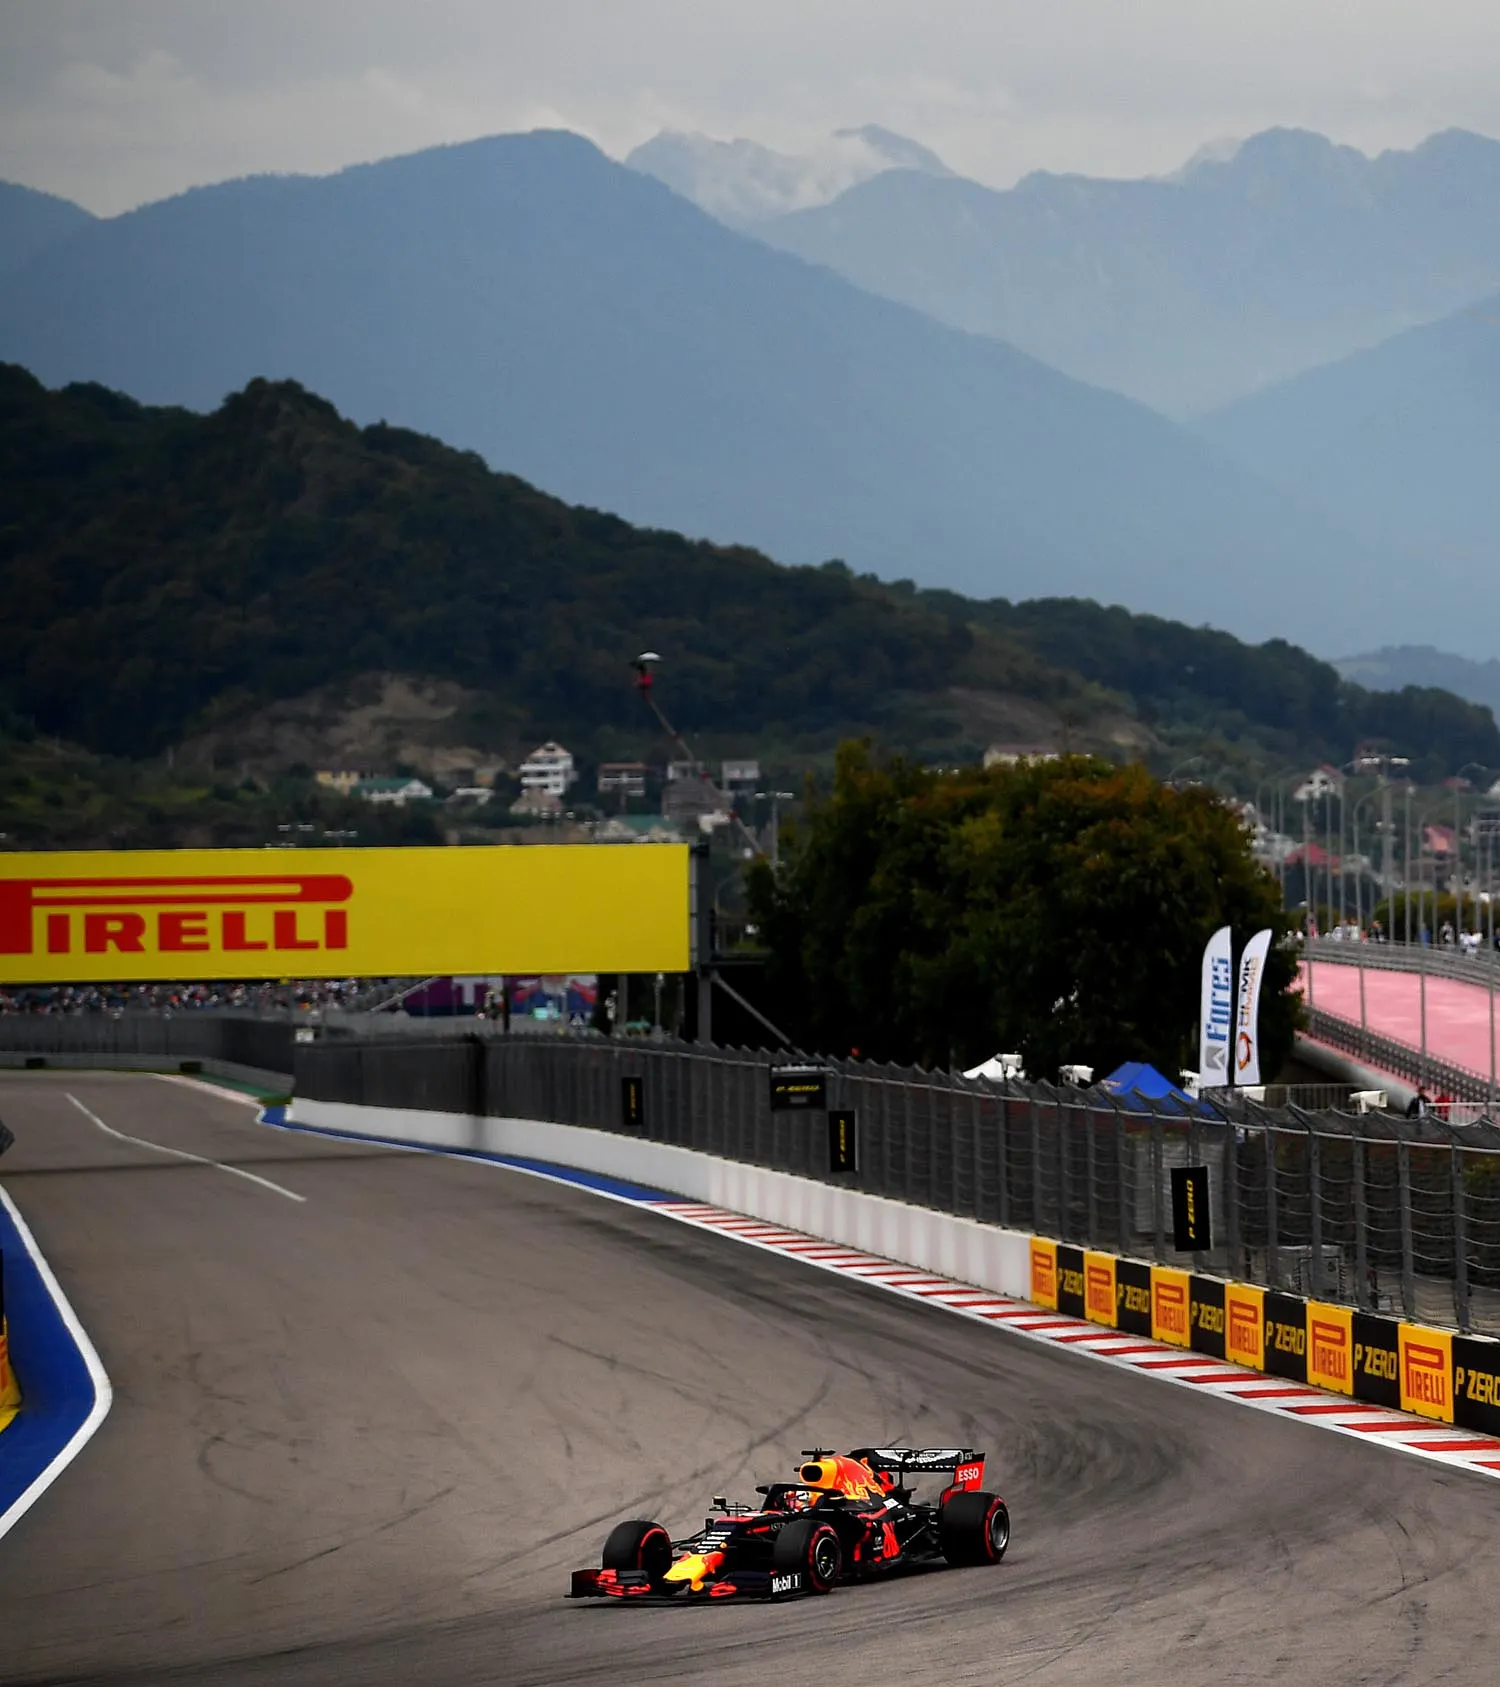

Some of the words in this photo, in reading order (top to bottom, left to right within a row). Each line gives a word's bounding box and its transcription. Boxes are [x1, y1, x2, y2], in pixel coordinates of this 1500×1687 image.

[0, 874, 354, 954] PIRELLI
[1057, 1268, 1063, 1292] P
[1064, 1270, 1084, 1296] ZERO
[1117, 1284, 1124, 1306] P
[1125, 1285, 1149, 1312] ZERO
[1156, 1282, 1185, 1334] PIRELLI
[1191, 1302, 1197, 1324] P
[1199, 1304, 1224, 1333] ZERO
[1229, 1299, 1258, 1355] PIRELLI
[1265, 1321, 1273, 1345] P
[1275, 1323, 1305, 1355] ZERO
[1312, 1320, 1346, 1380] PIRELLI
[1354, 1344, 1362, 1370] P
[1364, 1346, 1397, 1380] ZERO
[1404, 1342, 1445, 1406] PIRELLI
[1455, 1367, 1464, 1394] P
[958, 1467, 979, 1482] ESSO
[772, 1575, 791, 1593] Mobil
